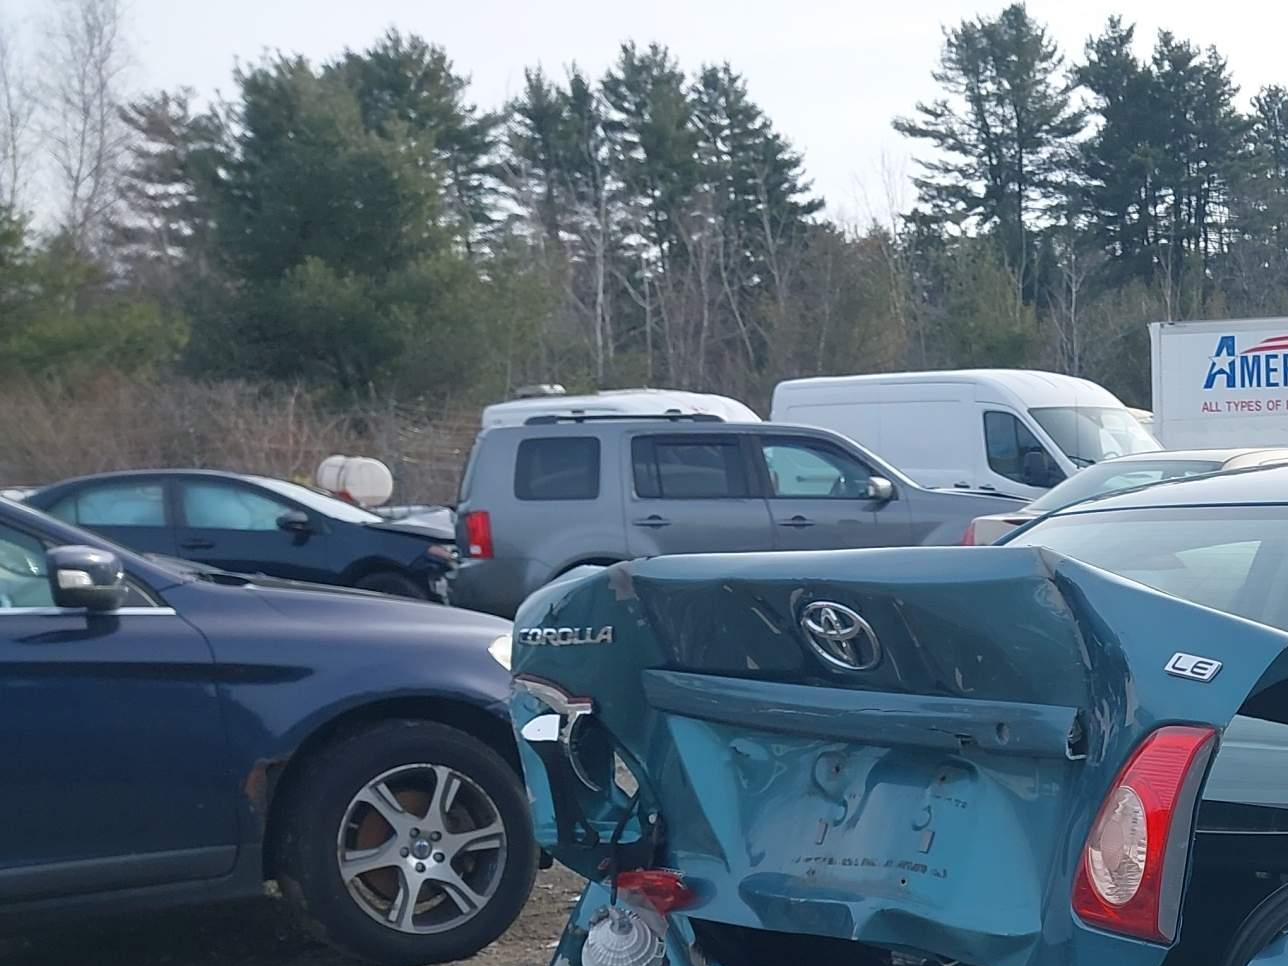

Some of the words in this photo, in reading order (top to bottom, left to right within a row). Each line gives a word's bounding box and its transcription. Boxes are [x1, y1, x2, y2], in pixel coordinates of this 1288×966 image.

[1201, 401, 1221, 412] ALL
[1226, 400, 1262, 412] TYPES
[1266, 399, 1281, 411] OF
[519, 625, 613, 646] COROLLA
[1171, 655, 1214, 676] LE
